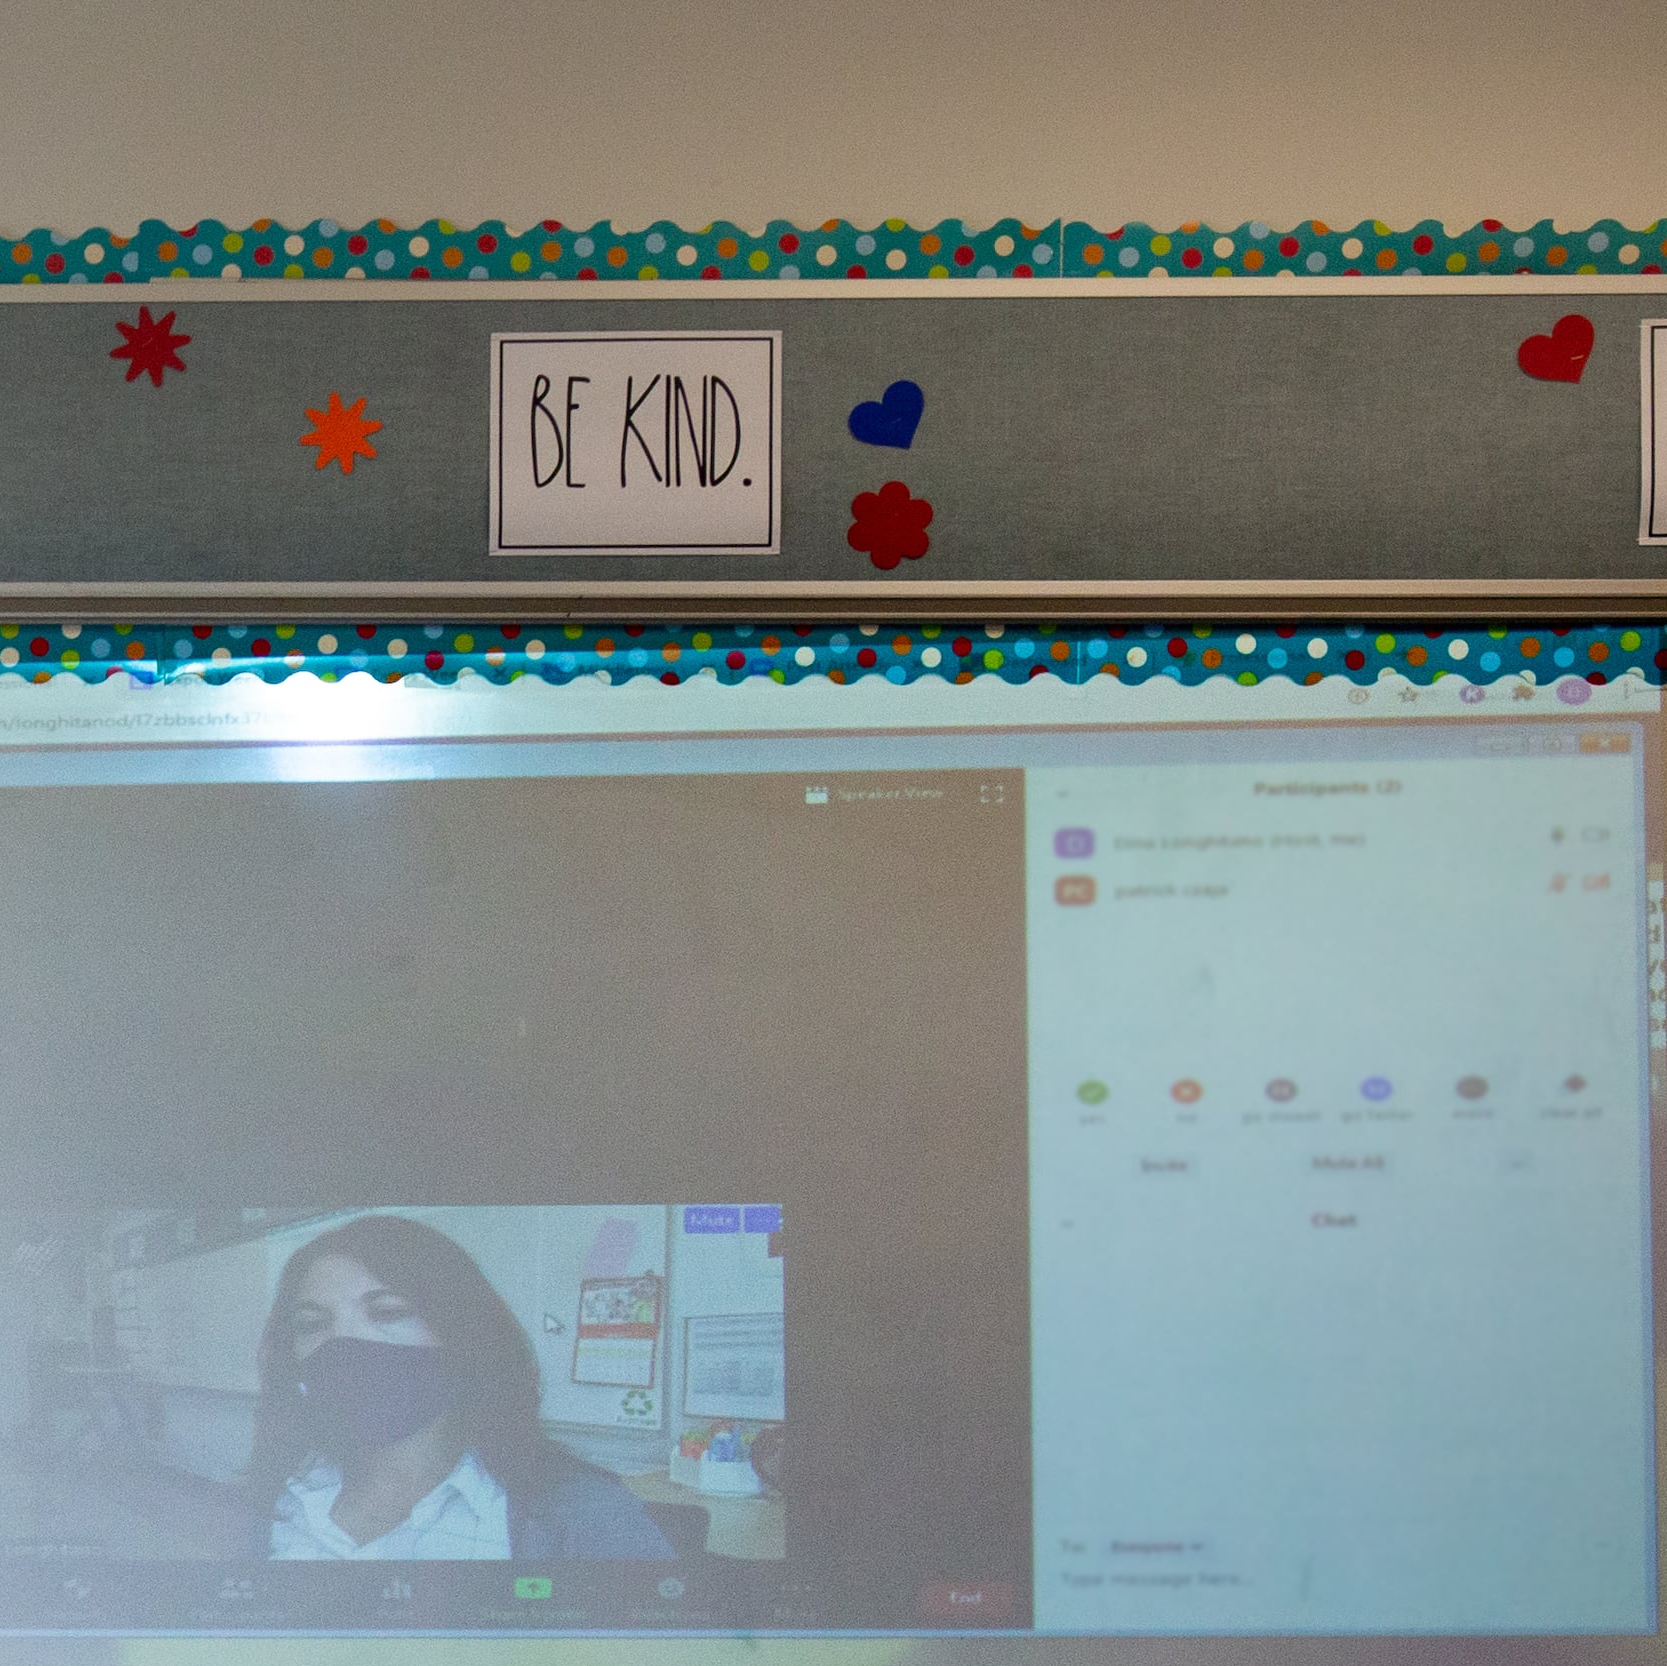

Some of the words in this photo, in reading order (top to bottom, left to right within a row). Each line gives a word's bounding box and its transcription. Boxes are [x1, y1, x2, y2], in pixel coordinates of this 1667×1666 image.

[529, 374, 590, 490] BE
[619, 372, 754, 490] KIND.
[1311, 1212, 1358, 1229] Chat
